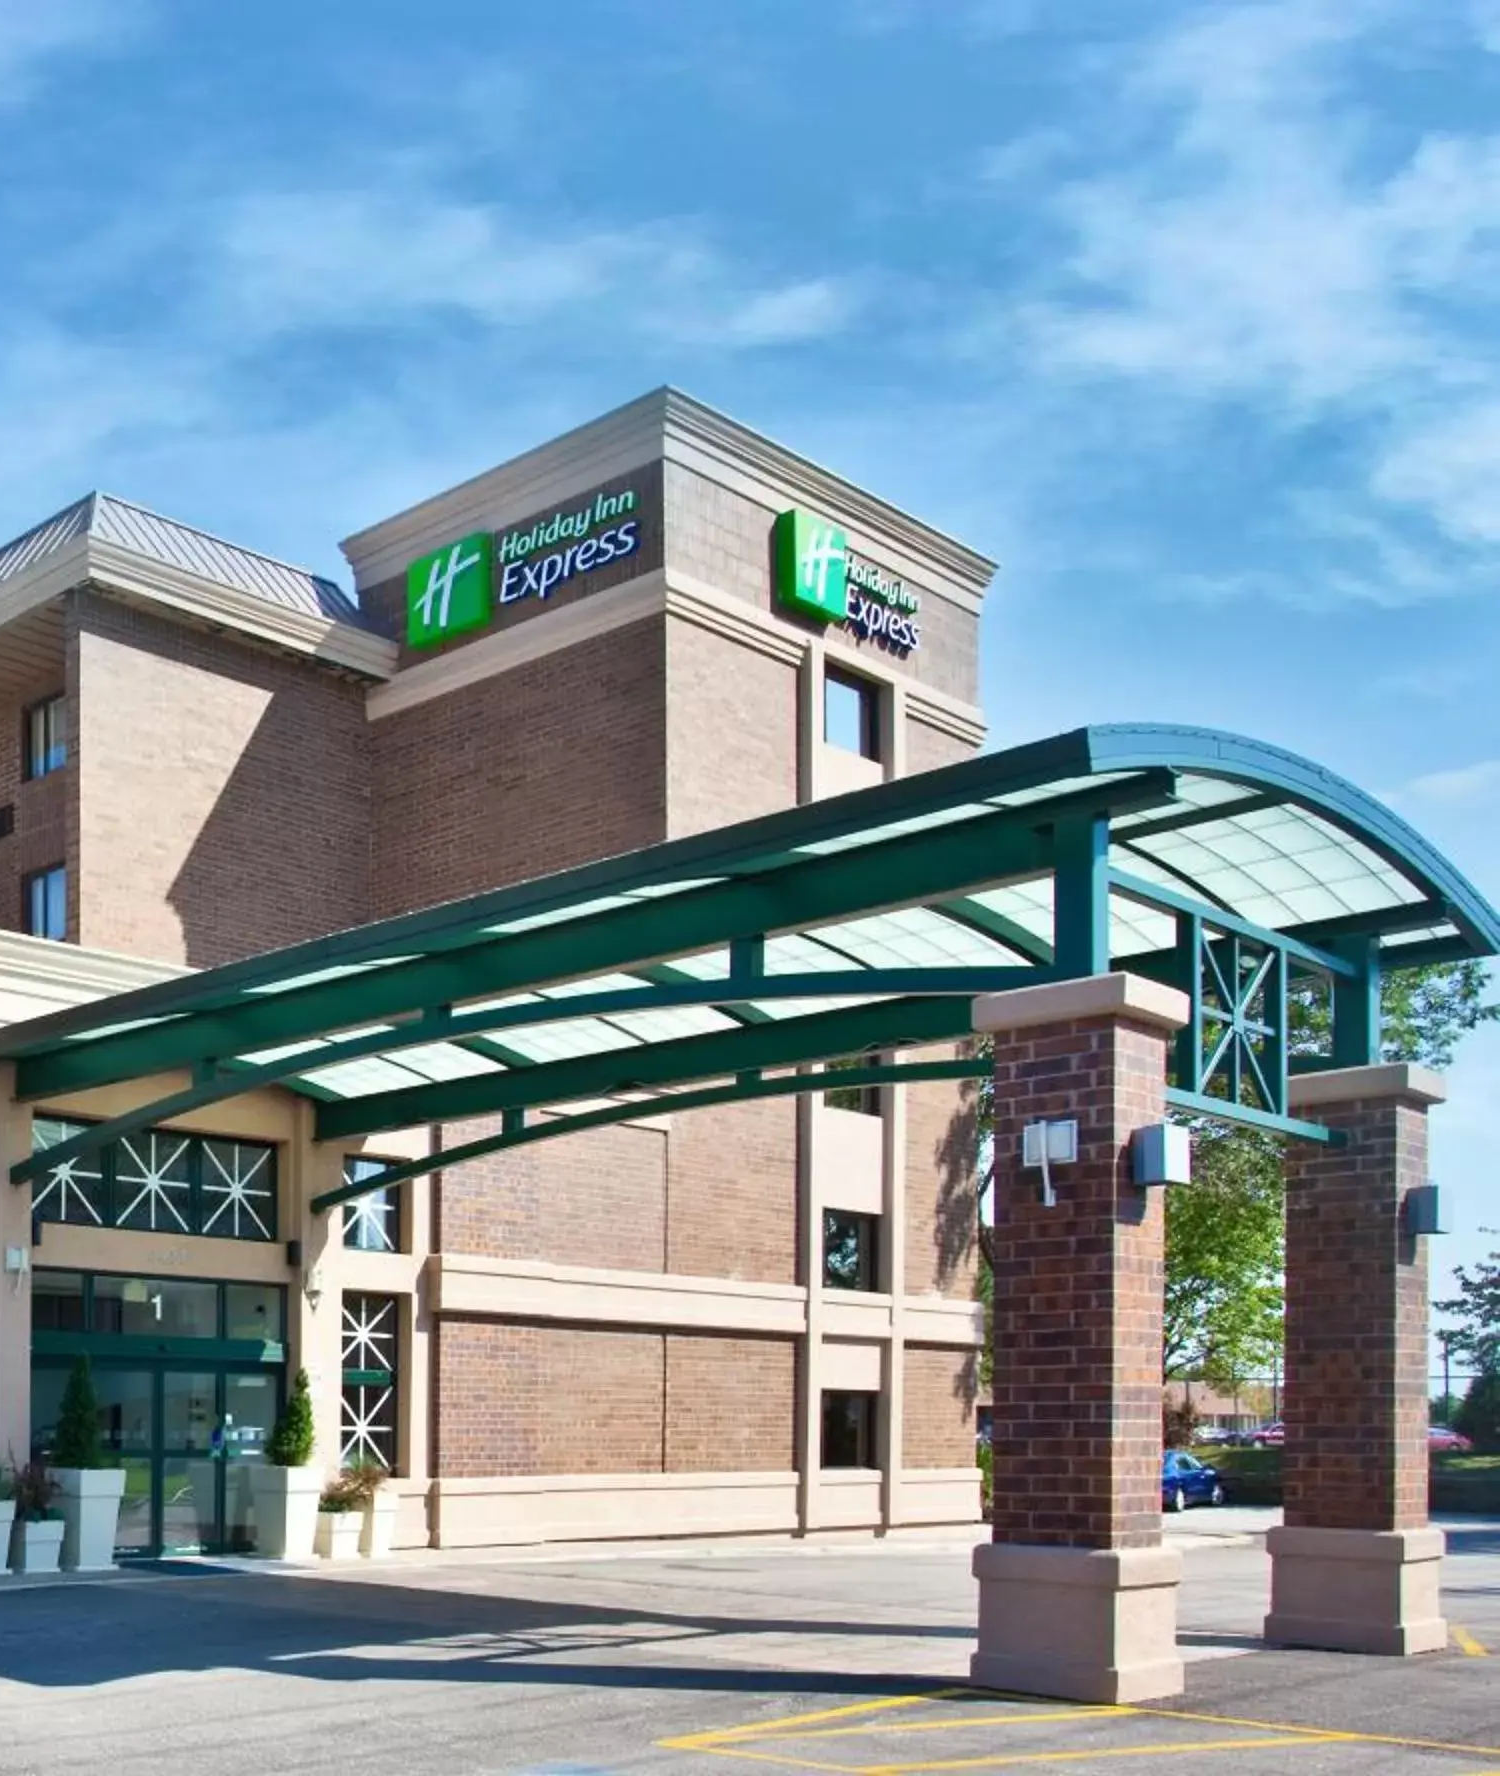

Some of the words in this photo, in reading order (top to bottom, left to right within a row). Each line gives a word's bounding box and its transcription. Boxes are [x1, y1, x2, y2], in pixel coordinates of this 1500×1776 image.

[499, 507, 592, 563] Holiday
[595, 490, 634, 522] Inn
[499, 521, 637, 603] Express
[845, 554, 898, 605] Holiday
[899, 581, 920, 610] Inn
[845, 584, 921, 650] Express
